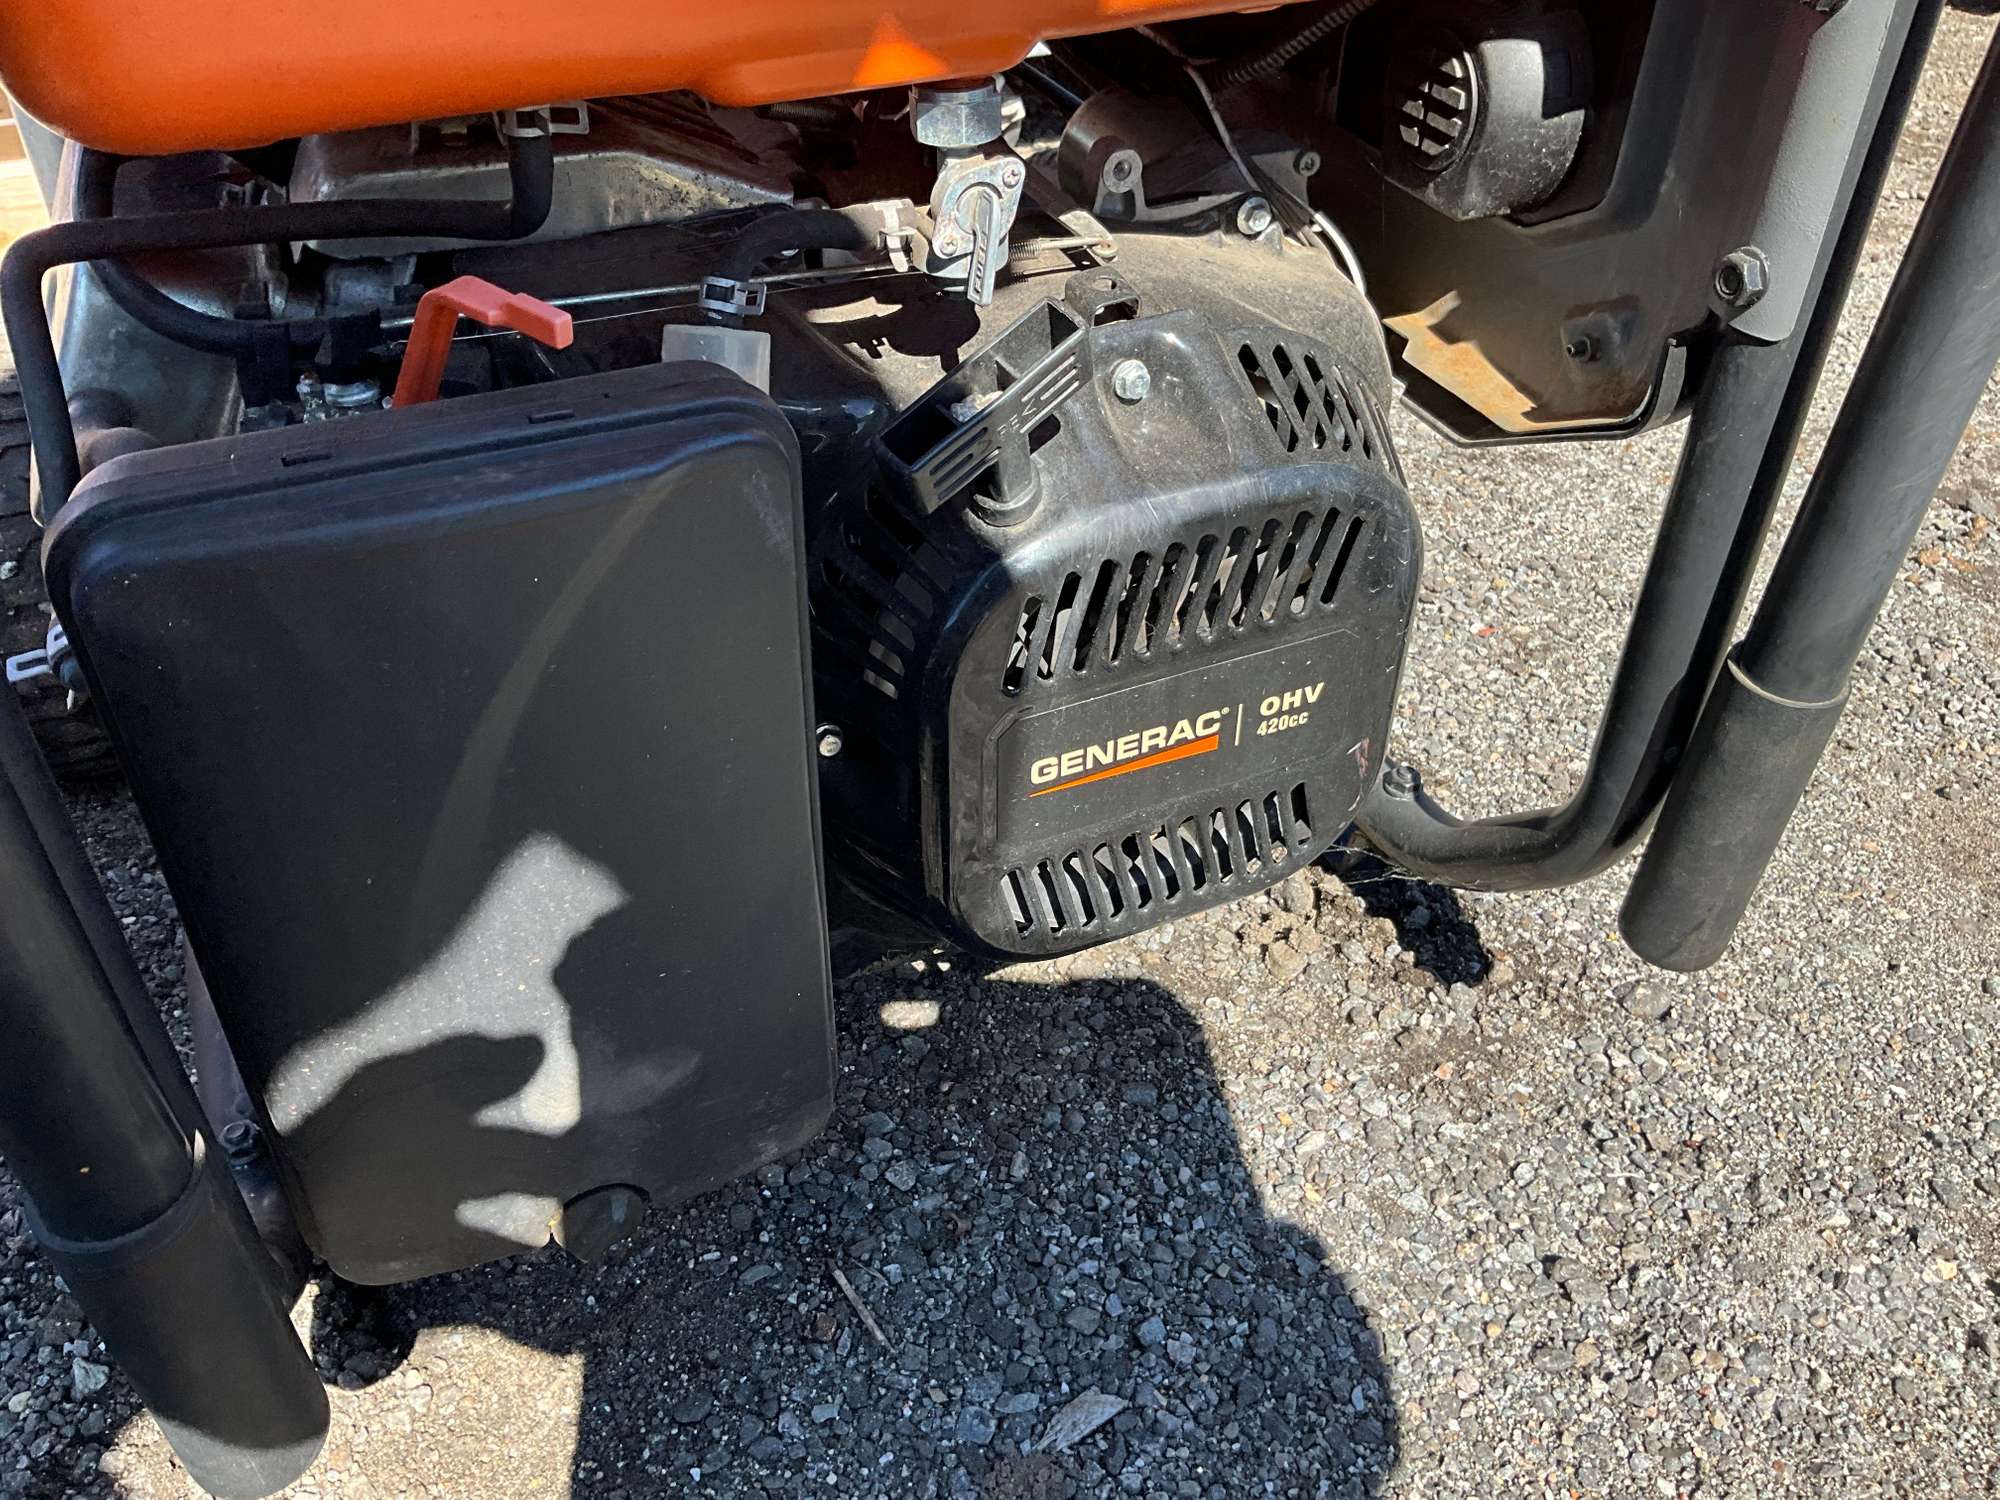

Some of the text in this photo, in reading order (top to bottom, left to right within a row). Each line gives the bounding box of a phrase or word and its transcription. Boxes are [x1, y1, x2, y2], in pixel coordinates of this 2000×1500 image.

[1259, 682, 1325, 717] OHV
[1256, 711, 1309, 737] 420cc
[1030, 709, 1223, 785] GENERAC
